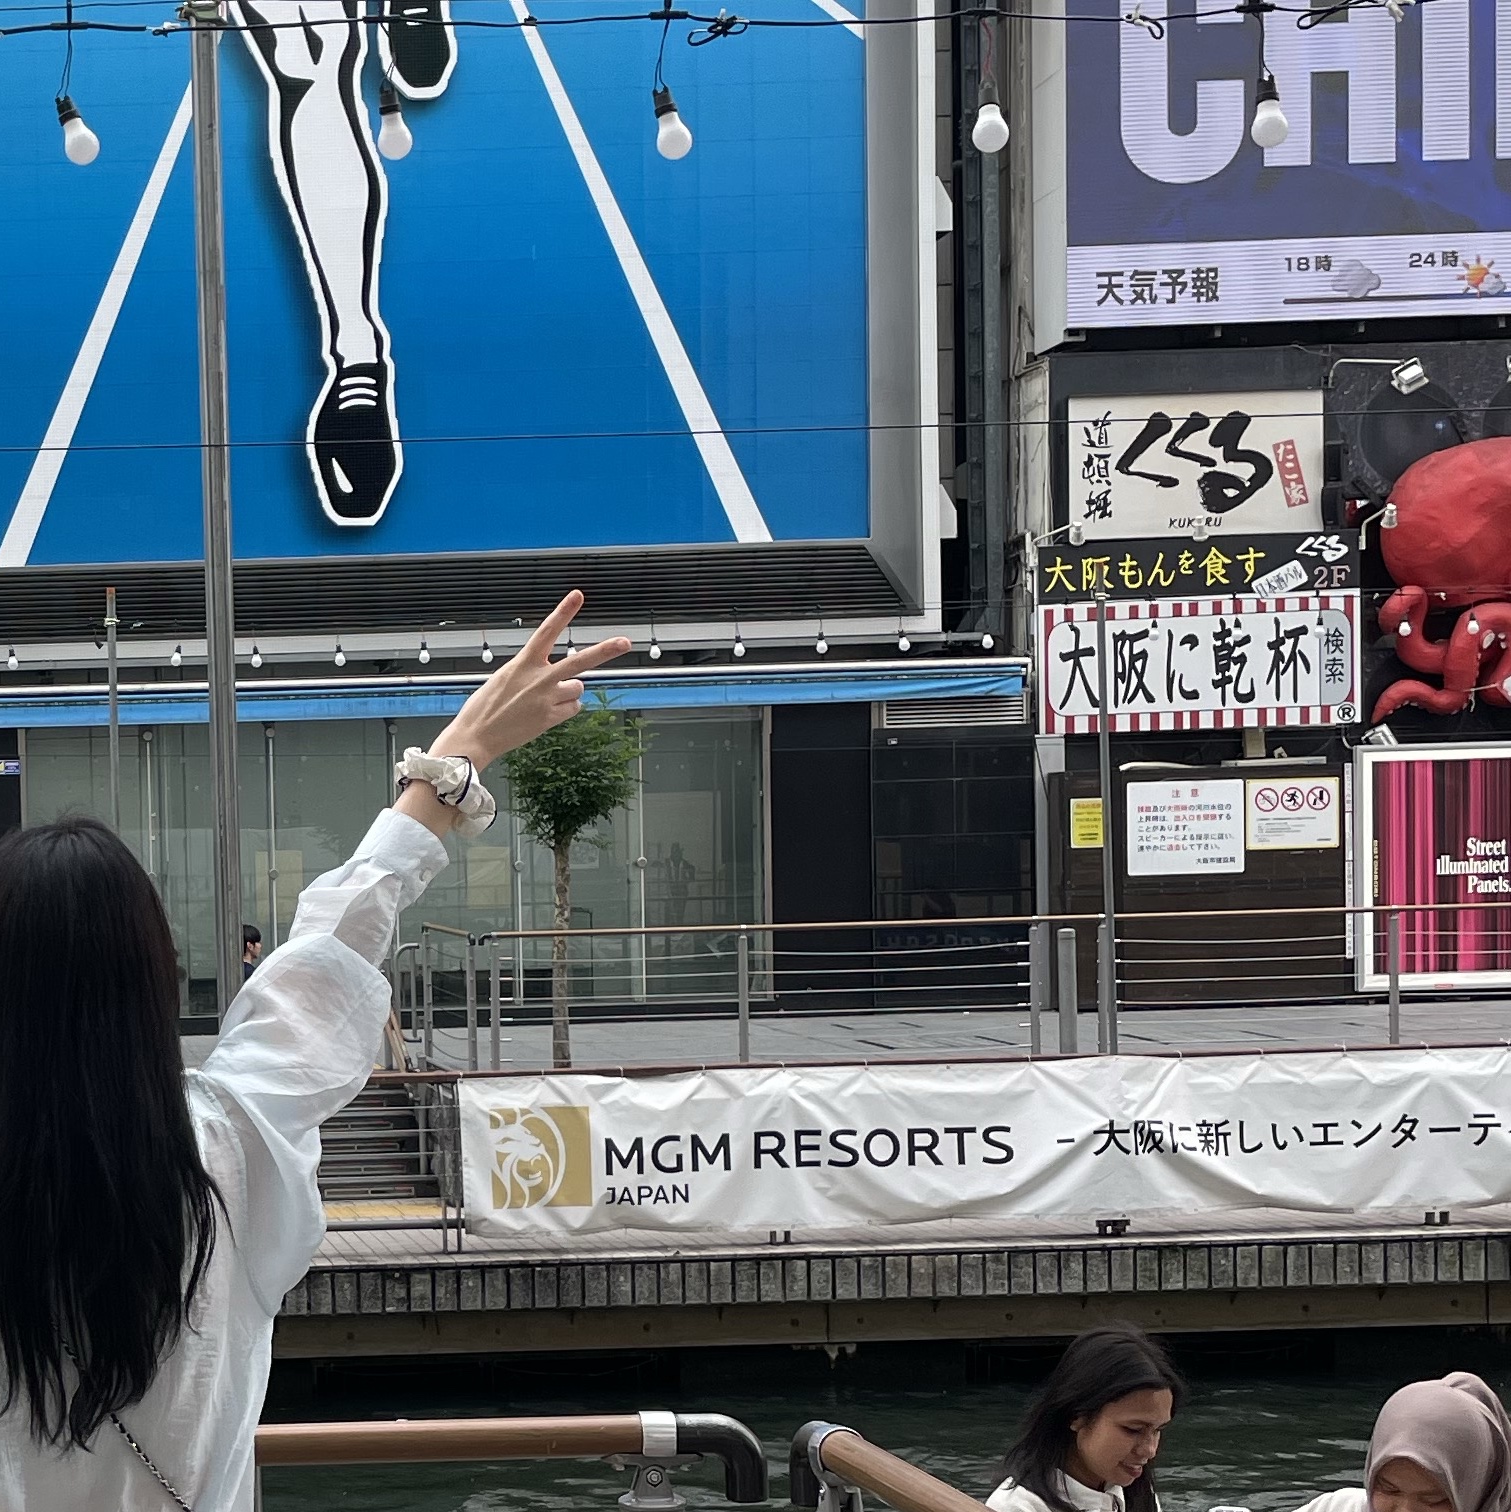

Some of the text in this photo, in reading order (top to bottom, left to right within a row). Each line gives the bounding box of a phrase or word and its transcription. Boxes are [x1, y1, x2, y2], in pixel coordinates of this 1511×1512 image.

[1119, 0, 1511, 184] CHI
[1095, 266, 1220, 306] 天気予報
[1081, 410, 1115, 523] 道頓堀
[1115, 411, 1274, 514] くくる
[1168, 516, 1223, 529] KUKRU
[1295, 534, 1349, 562] くくる
[1044, 546, 1266, 593] 大阪もんを食す
[1313, 564, 1351, 588] 2F
[1059, 617, 1311, 711] 大阪に乾杯
[1322, 627, 1347, 685] 検索
[1436, 854, 1509, 876] Illuminated
[1466, 836, 1507, 857] Street
[1467, 874, 1511, 893] Panels.
[604, 1125, 1015, 1176] MGM RESORTS
[1092, 1112, 1511, 1157] 大阪に新しいエンターテ
[605, 1183, 689, 1206] JAPAN
